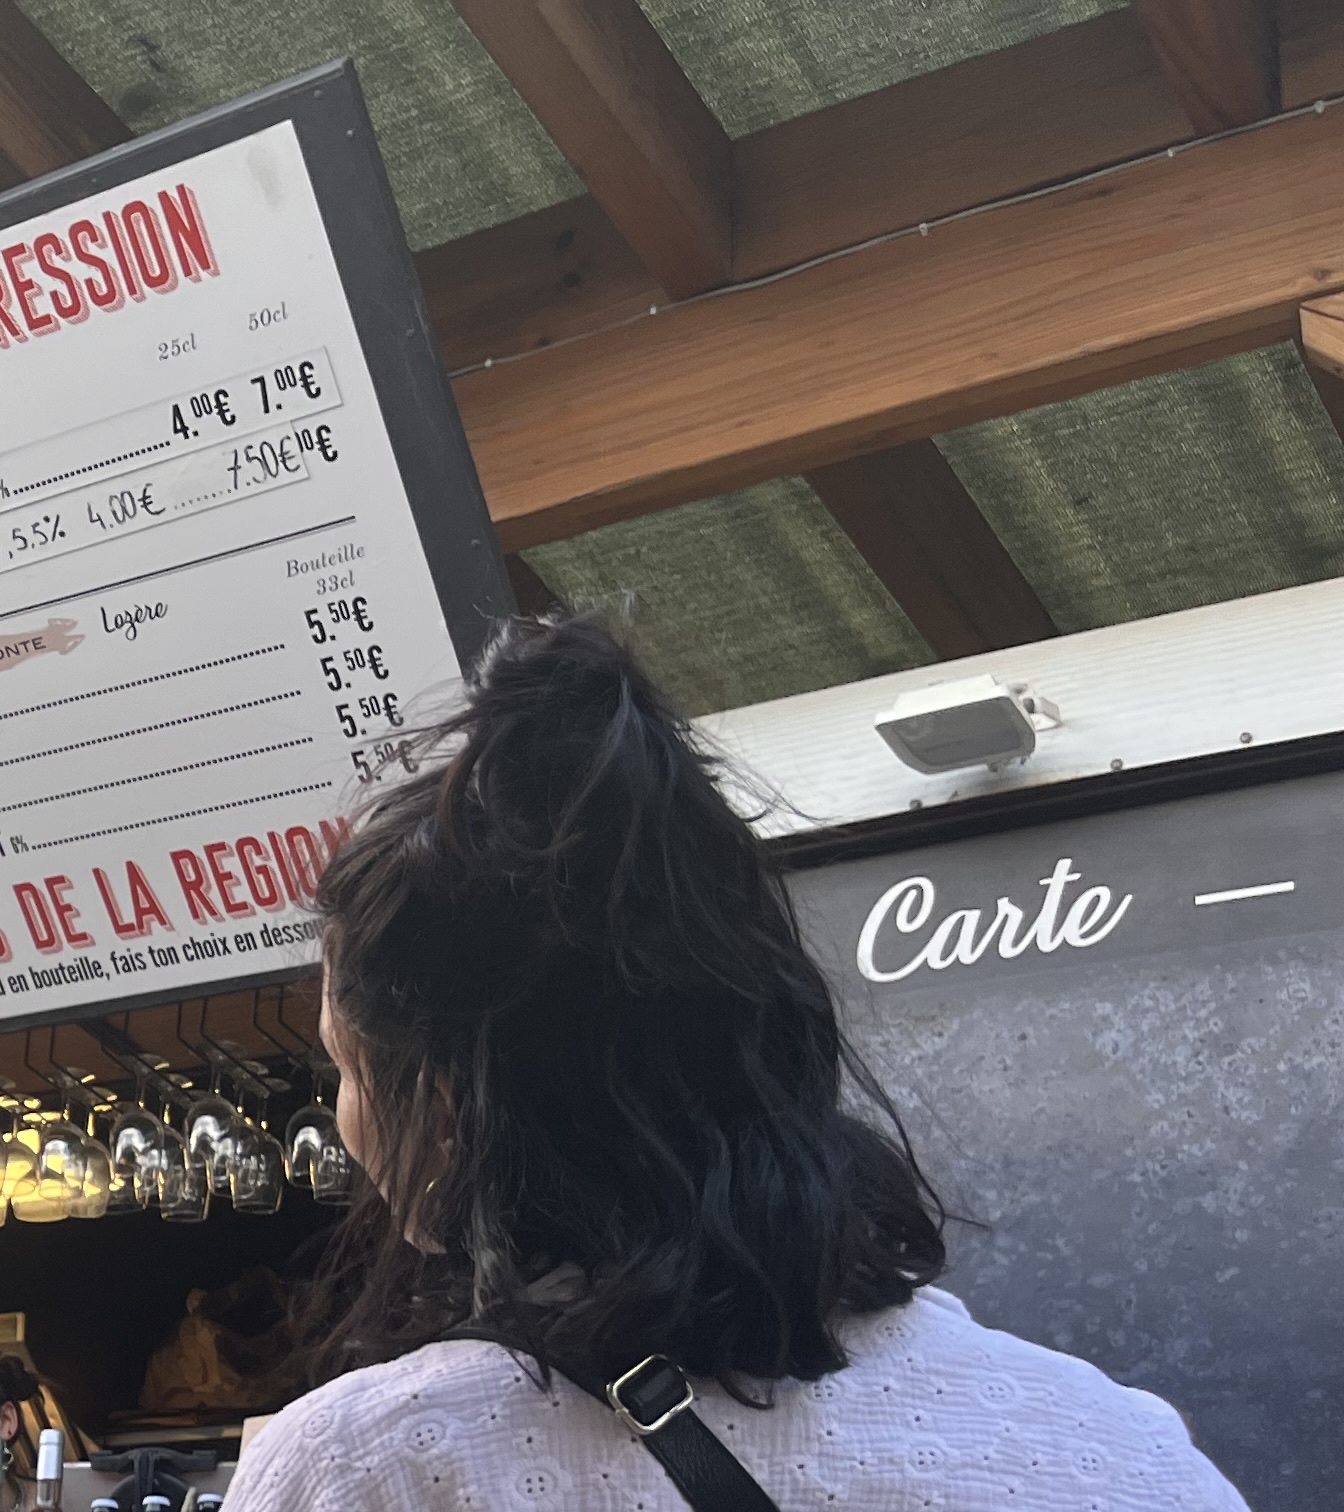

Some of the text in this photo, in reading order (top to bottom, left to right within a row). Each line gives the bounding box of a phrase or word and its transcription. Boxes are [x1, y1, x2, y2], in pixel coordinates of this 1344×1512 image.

[158, 301, 286, 360] 25cl 50cl
[172, 388, 235, 439] 4.00€
[250, 360, 321, 413] 7.00€
[286, 543, 363, 577] Bouteille
[316, 570, 354, 595] 33cl
[304, 596, 373, 644] 5.50€
[319, 644, 389, 691] 5.50€
[12, 874, 96, 954] DE
[91, 860, 174, 940] LA
[856, 858, 1134, 983] Carte
[7, 974, 29, 993] en
[28, 956, 110, 989] bouteille,
[109, 947, 146, 974] fais
[147, 945, 180, 967] ton
[181, 932, 231, 961] choix
[233, 931, 257, 952] en
